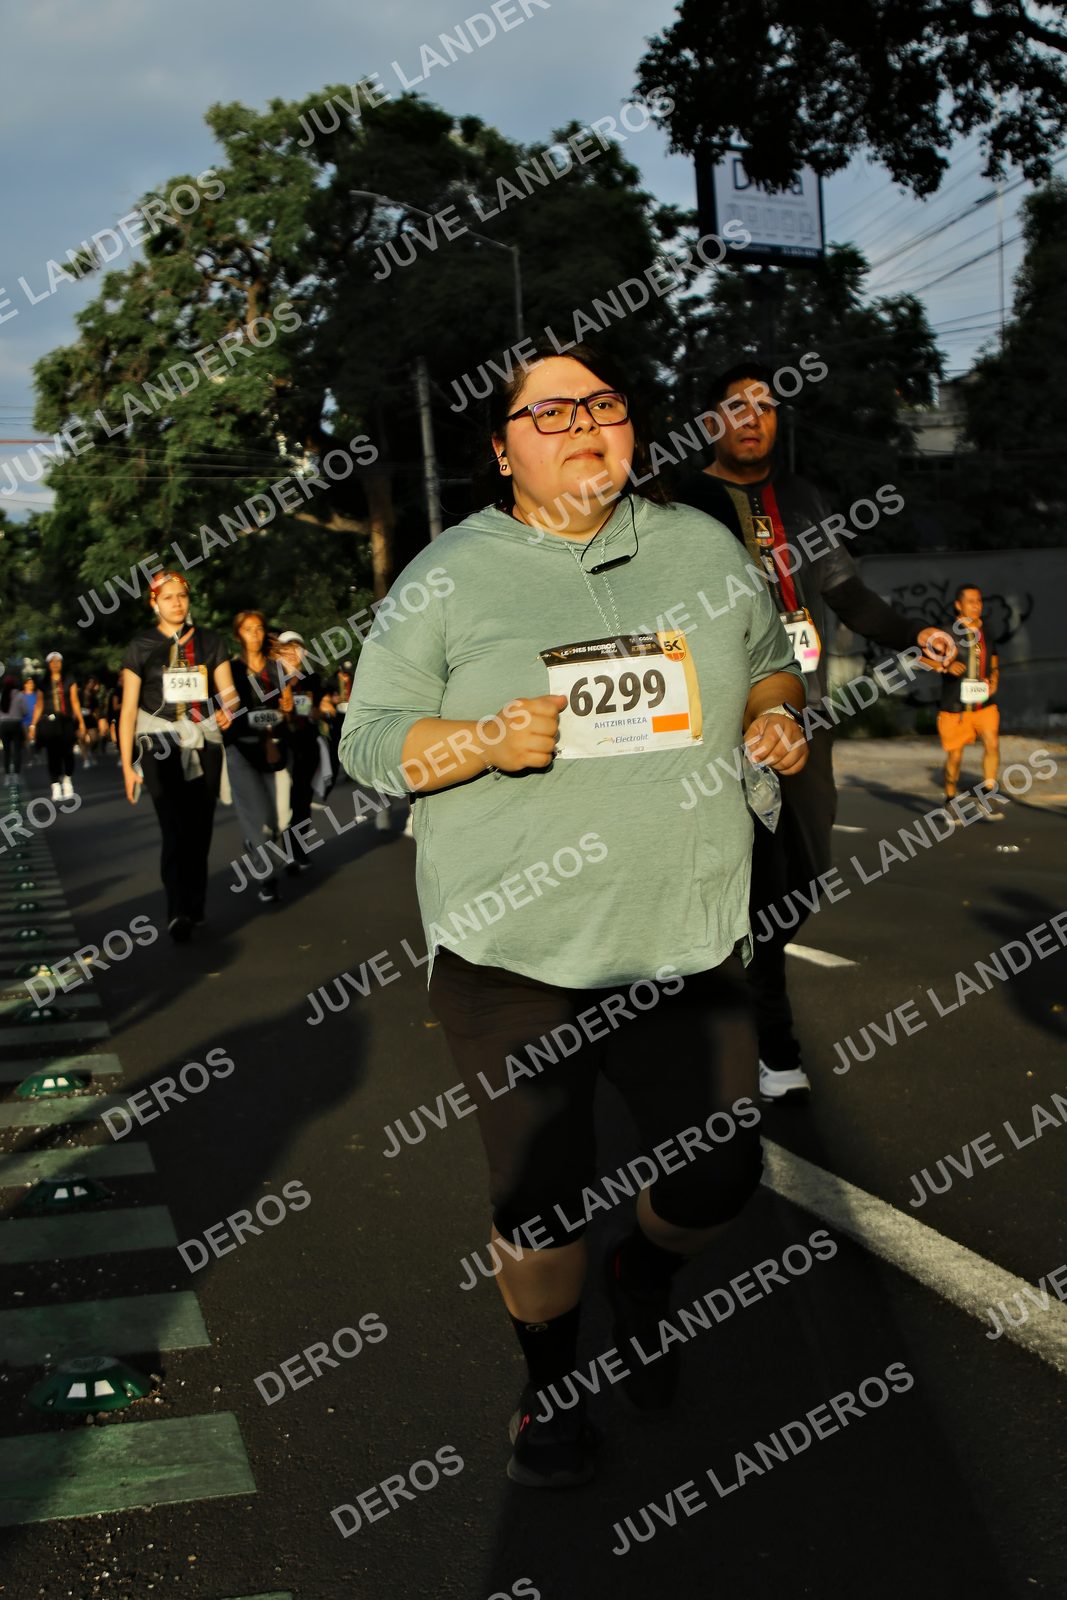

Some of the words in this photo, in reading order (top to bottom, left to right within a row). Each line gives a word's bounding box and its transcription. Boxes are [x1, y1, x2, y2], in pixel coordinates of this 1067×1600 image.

[170, 677, 199, 689] 5941
[569, 668, 666, 719] 6299
[594, 718, 627, 729] AHTZIRI
[627, 716, 648, 726] REZA
